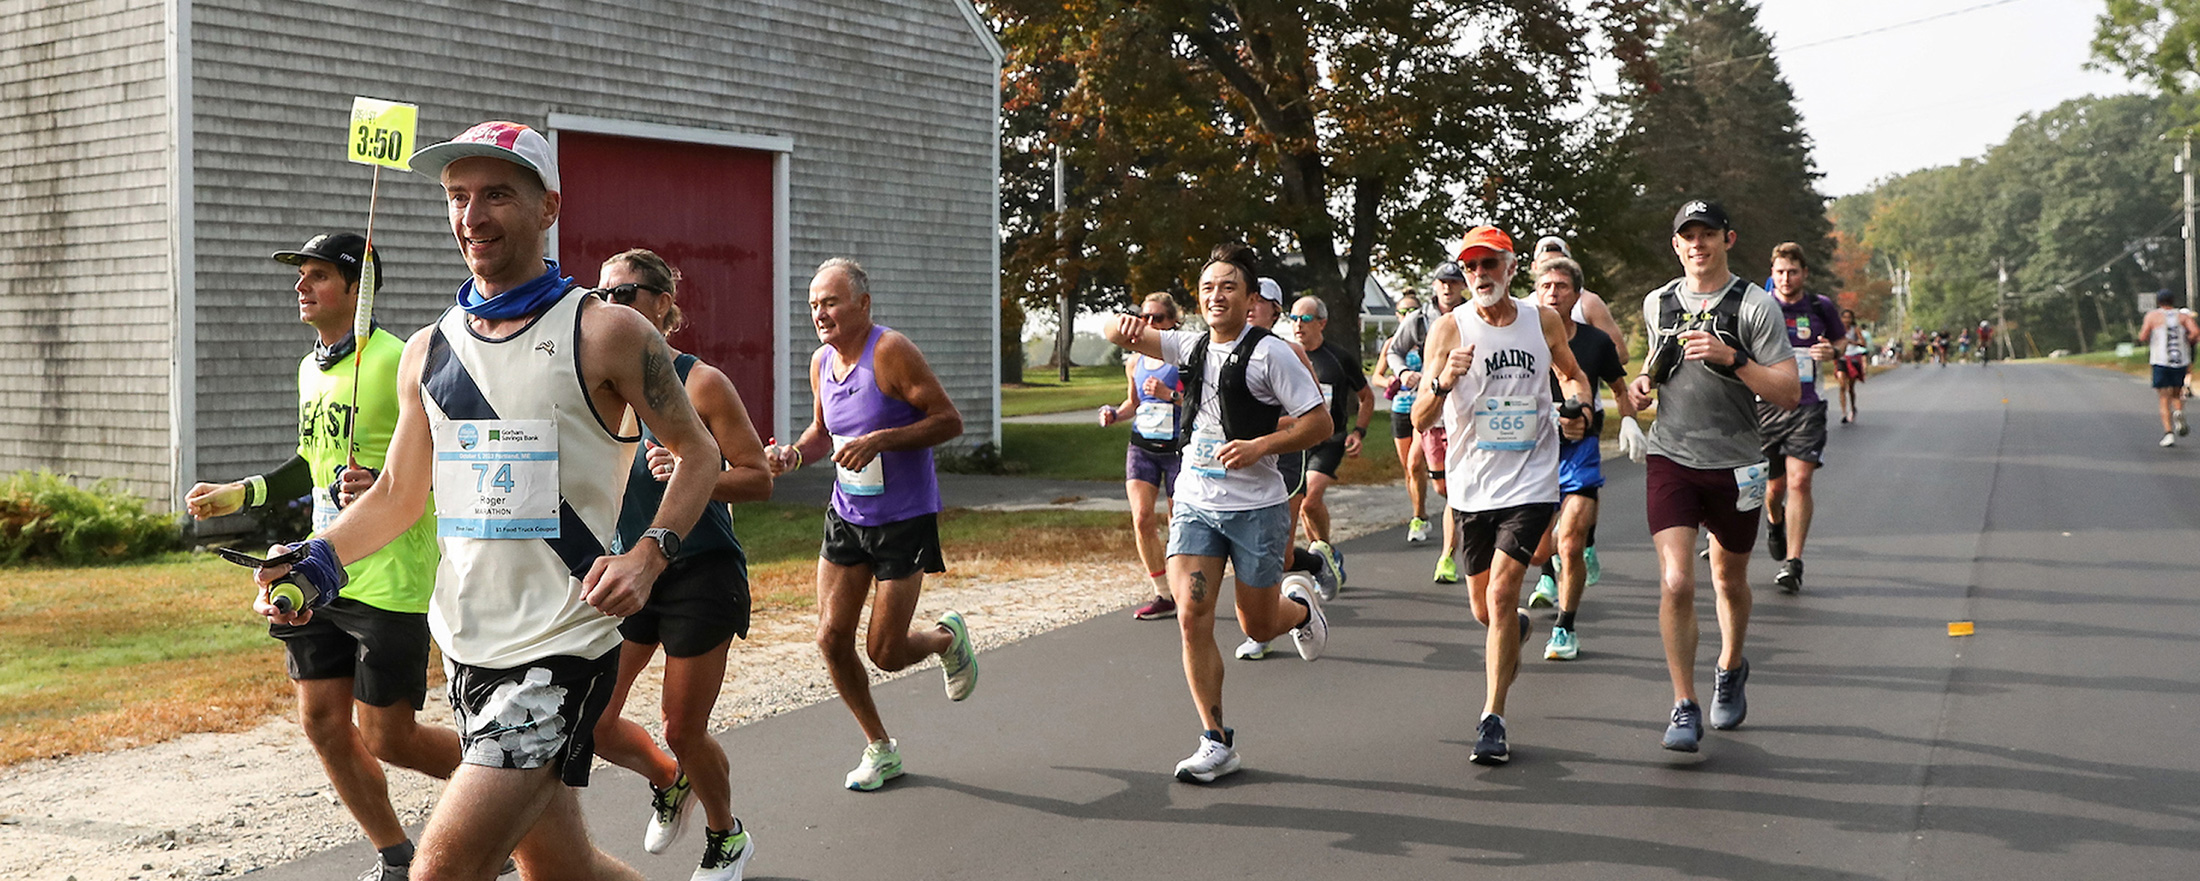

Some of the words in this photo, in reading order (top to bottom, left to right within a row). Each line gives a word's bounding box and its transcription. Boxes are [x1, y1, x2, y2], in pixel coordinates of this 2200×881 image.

[357, 125, 402, 162] 3:50
[1484, 348, 1536, 377] MAINE
[1489, 416, 1525, 431] 666
[501, 435, 523, 443] Savings
[472, 463, 515, 493] 74
[480, 495, 506, 507] Roger
[475, 508, 512, 516] MARATHON
[535, 525, 557, 533] Coupon
